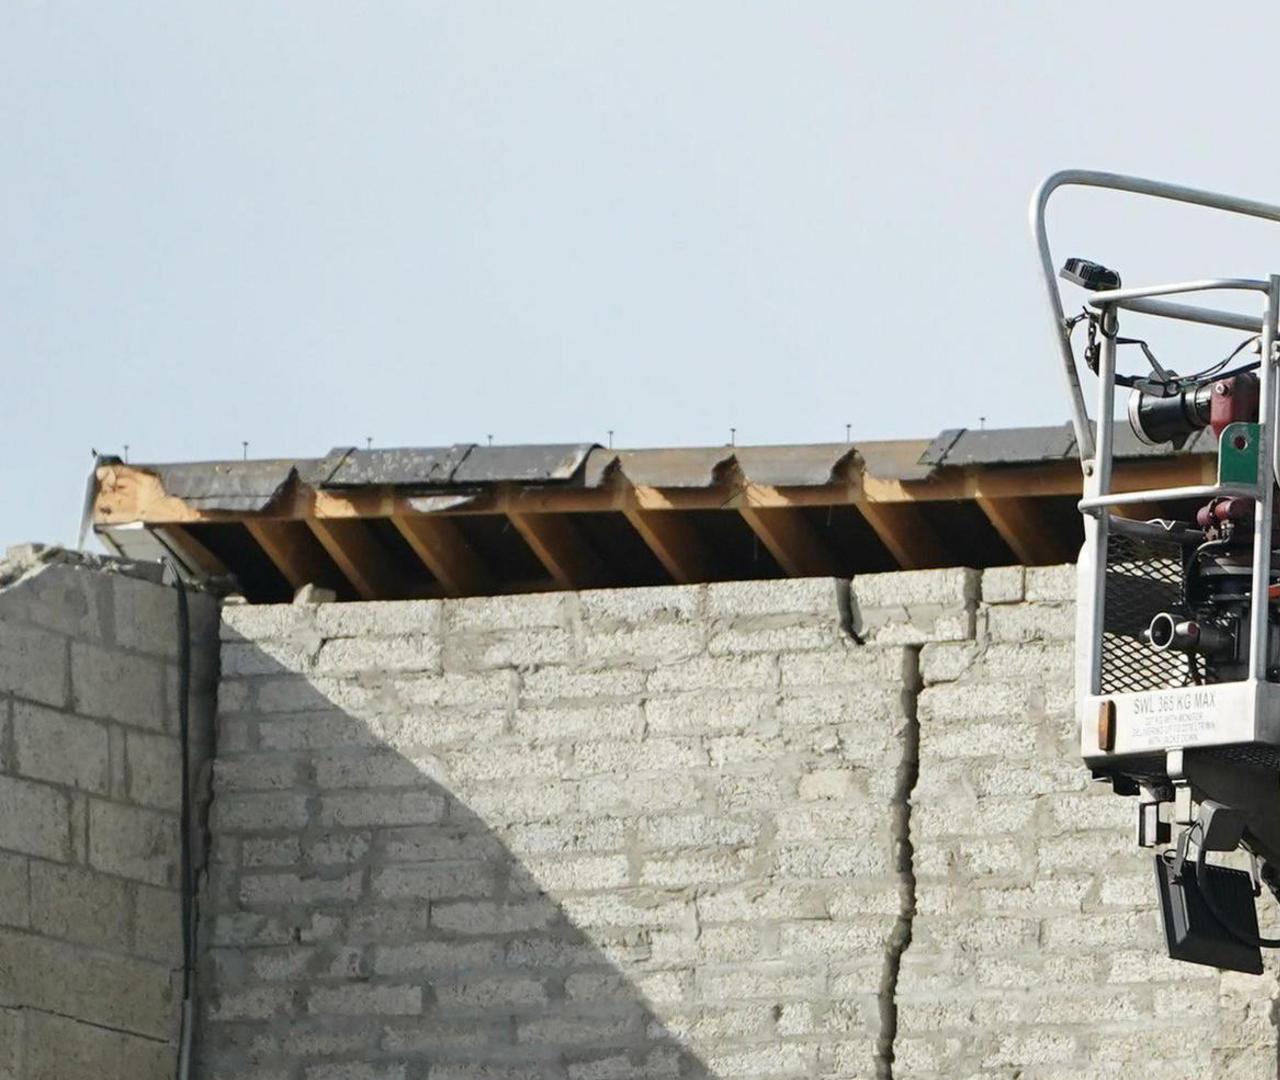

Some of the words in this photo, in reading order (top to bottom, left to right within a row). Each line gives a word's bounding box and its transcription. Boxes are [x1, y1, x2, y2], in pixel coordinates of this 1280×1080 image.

[1133, 695, 1155, 715] SWL
[1178, 692, 1192, 711] KG
[1194, 690, 1216, 709] MAX
